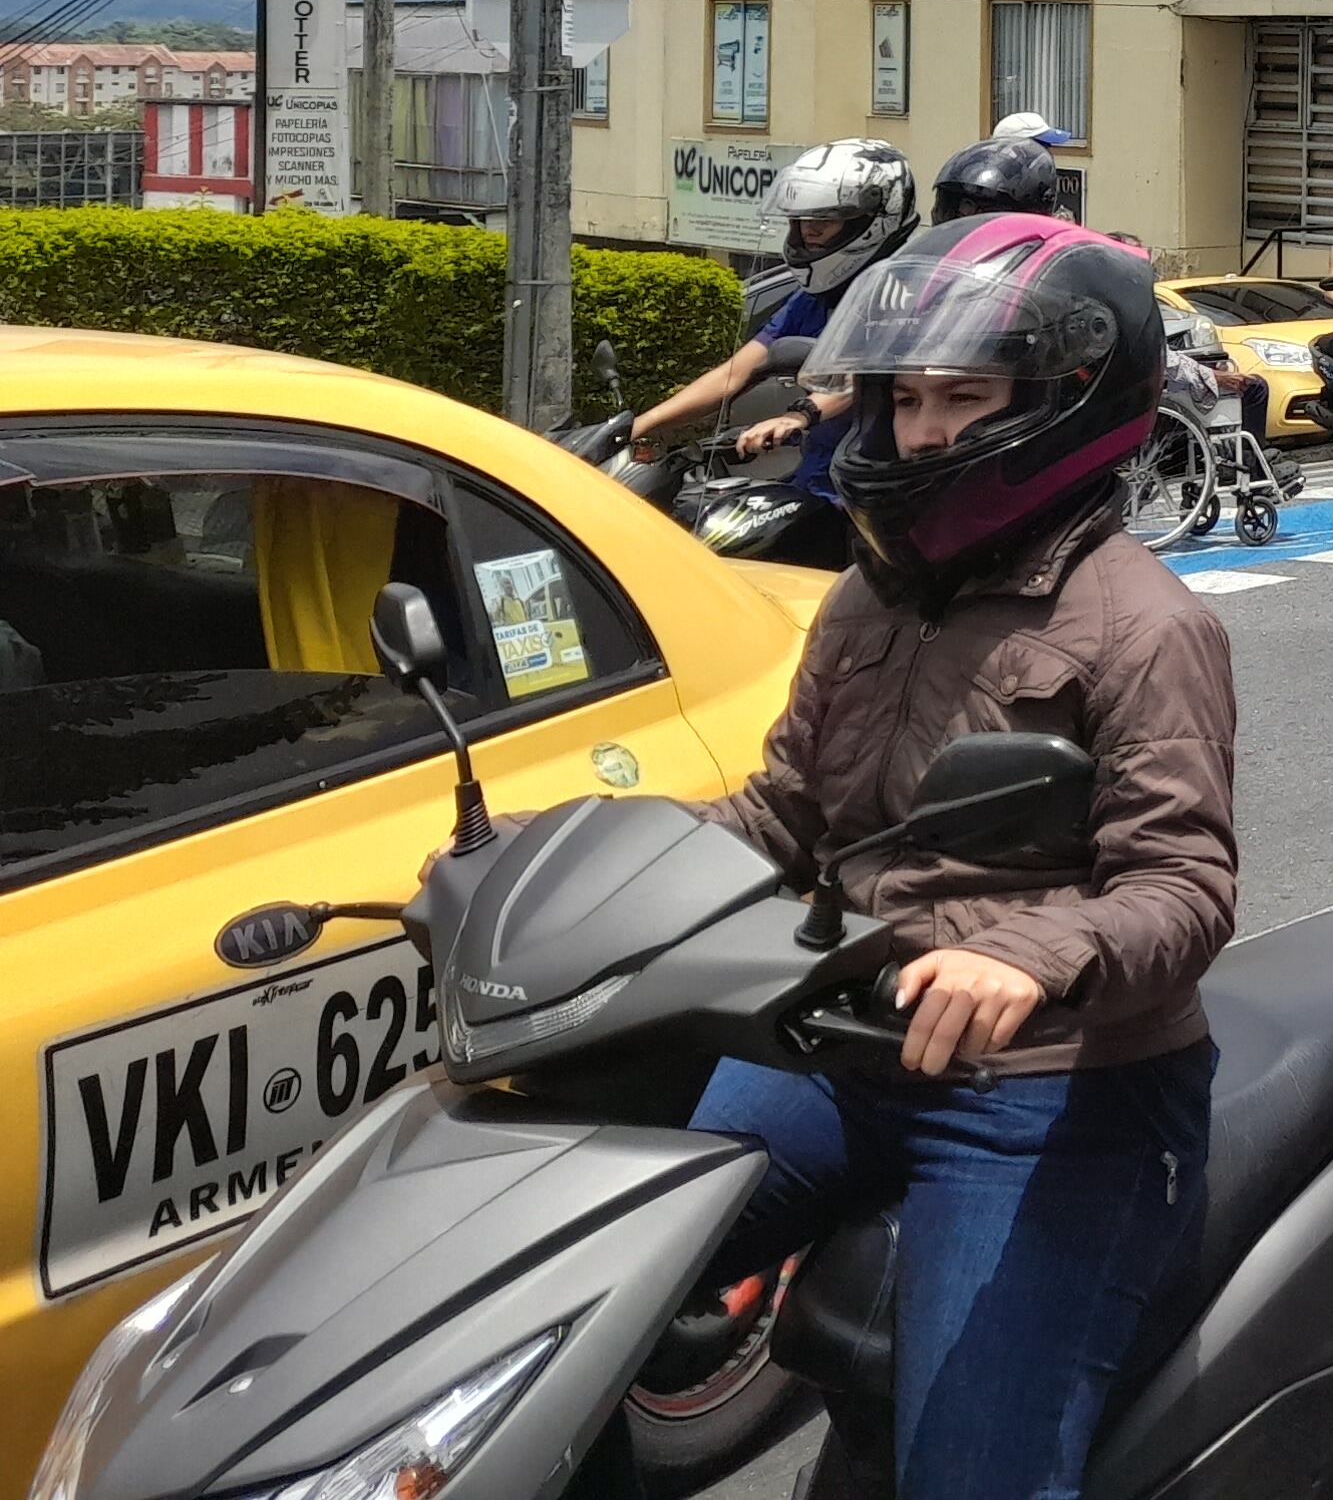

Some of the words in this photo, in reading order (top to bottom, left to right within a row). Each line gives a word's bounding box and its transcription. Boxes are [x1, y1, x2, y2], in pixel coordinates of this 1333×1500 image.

[275, 117, 328, 129] PAPELERÍA
[271, 132, 331, 143] FOTOCOPIAS
[268, 147, 335, 157] IMPRESIONES
[278, 161, 325, 171] SCANNER
[266, 175, 272, 185] Y
[275, 175, 311, 185] MUCHO
[231, 910, 311, 961] KIA
[458, 972, 529, 1001] HONDA
[77, 1023, 250, 1204] VKI
[148, 1139, 325, 1239] ARME
